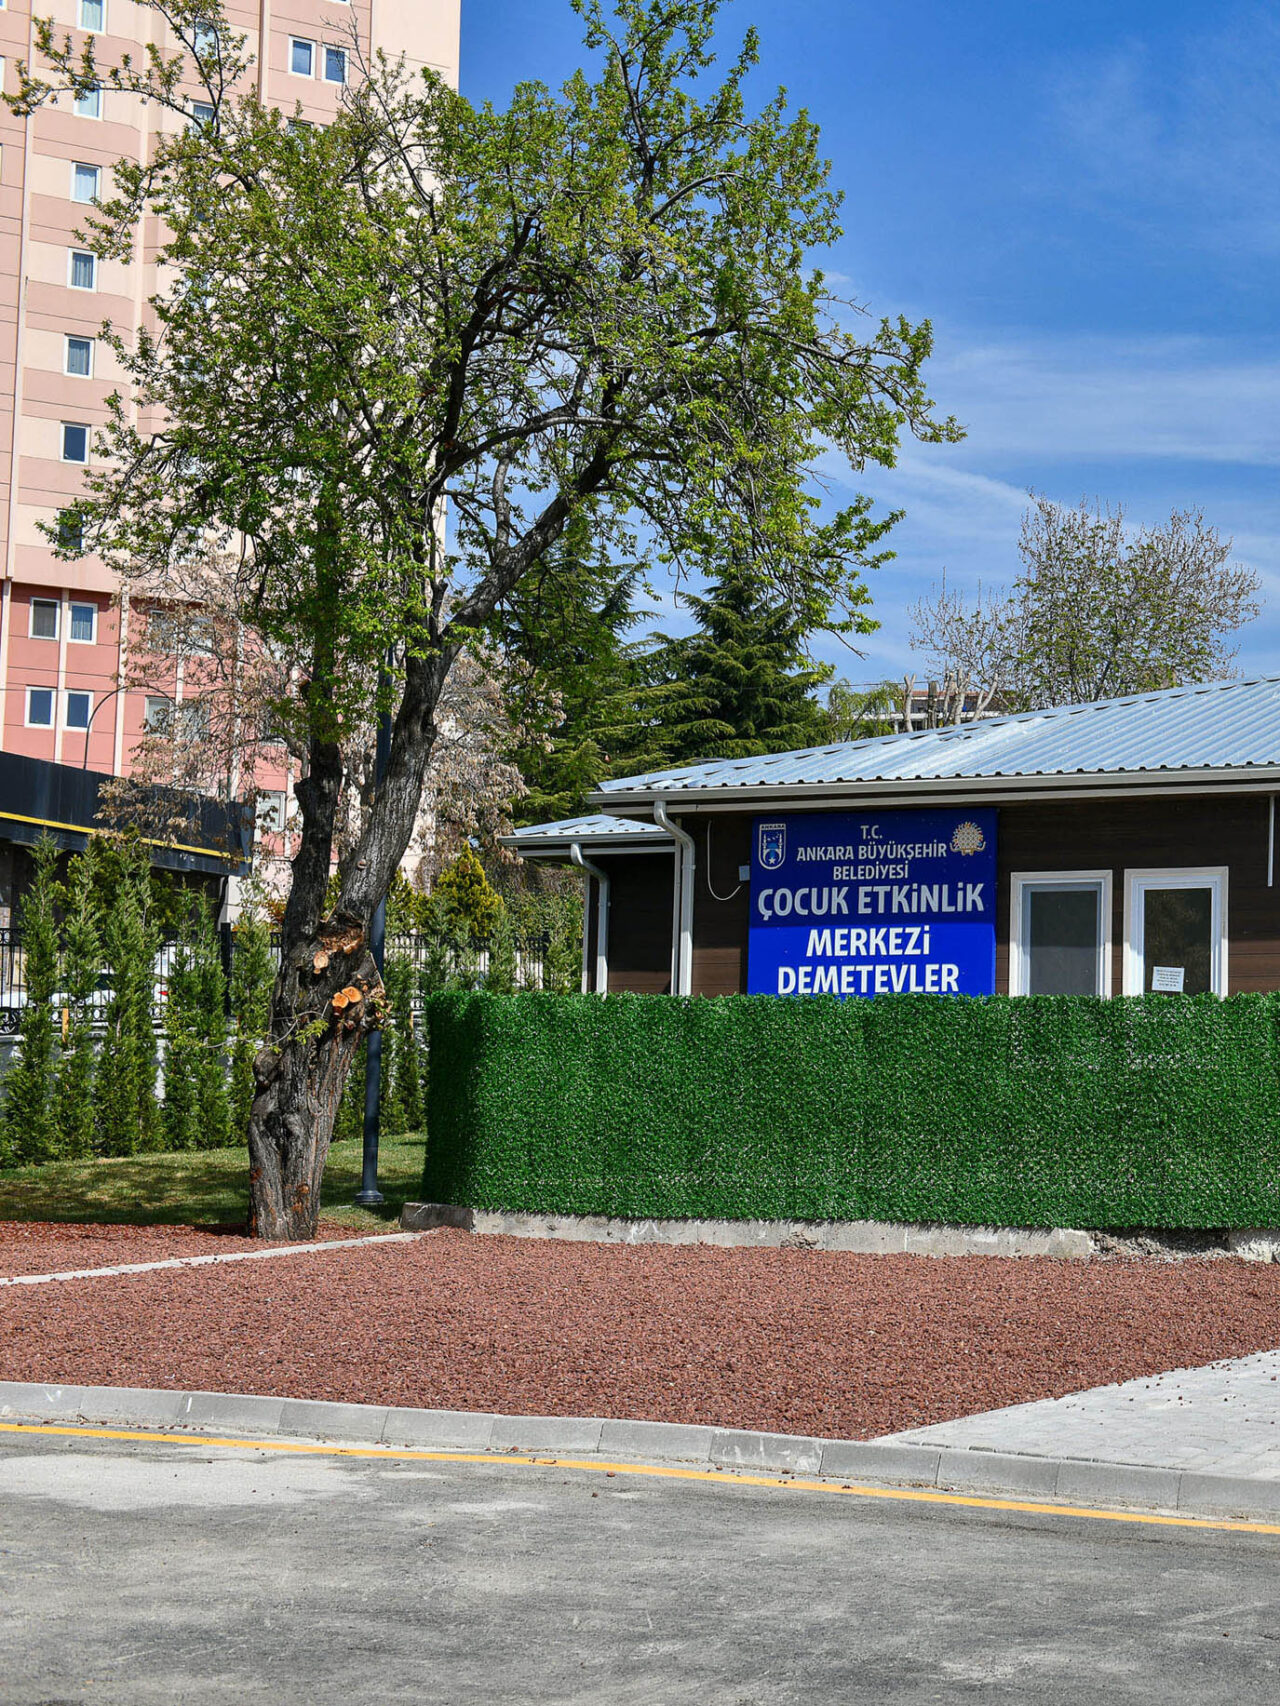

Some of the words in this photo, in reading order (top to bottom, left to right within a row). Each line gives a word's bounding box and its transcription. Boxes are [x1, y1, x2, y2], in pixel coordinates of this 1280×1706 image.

[861, 825, 883, 840] T.C.
[797, 845, 854, 862] ANKARA
[858, 839, 947, 862] BÜYÜKŞEHİR
[833, 861, 909, 881] BELEDİYESİ
[758, 886, 849, 921] ÇOCUK
[778, 963, 959, 994] DEMETEVLER
